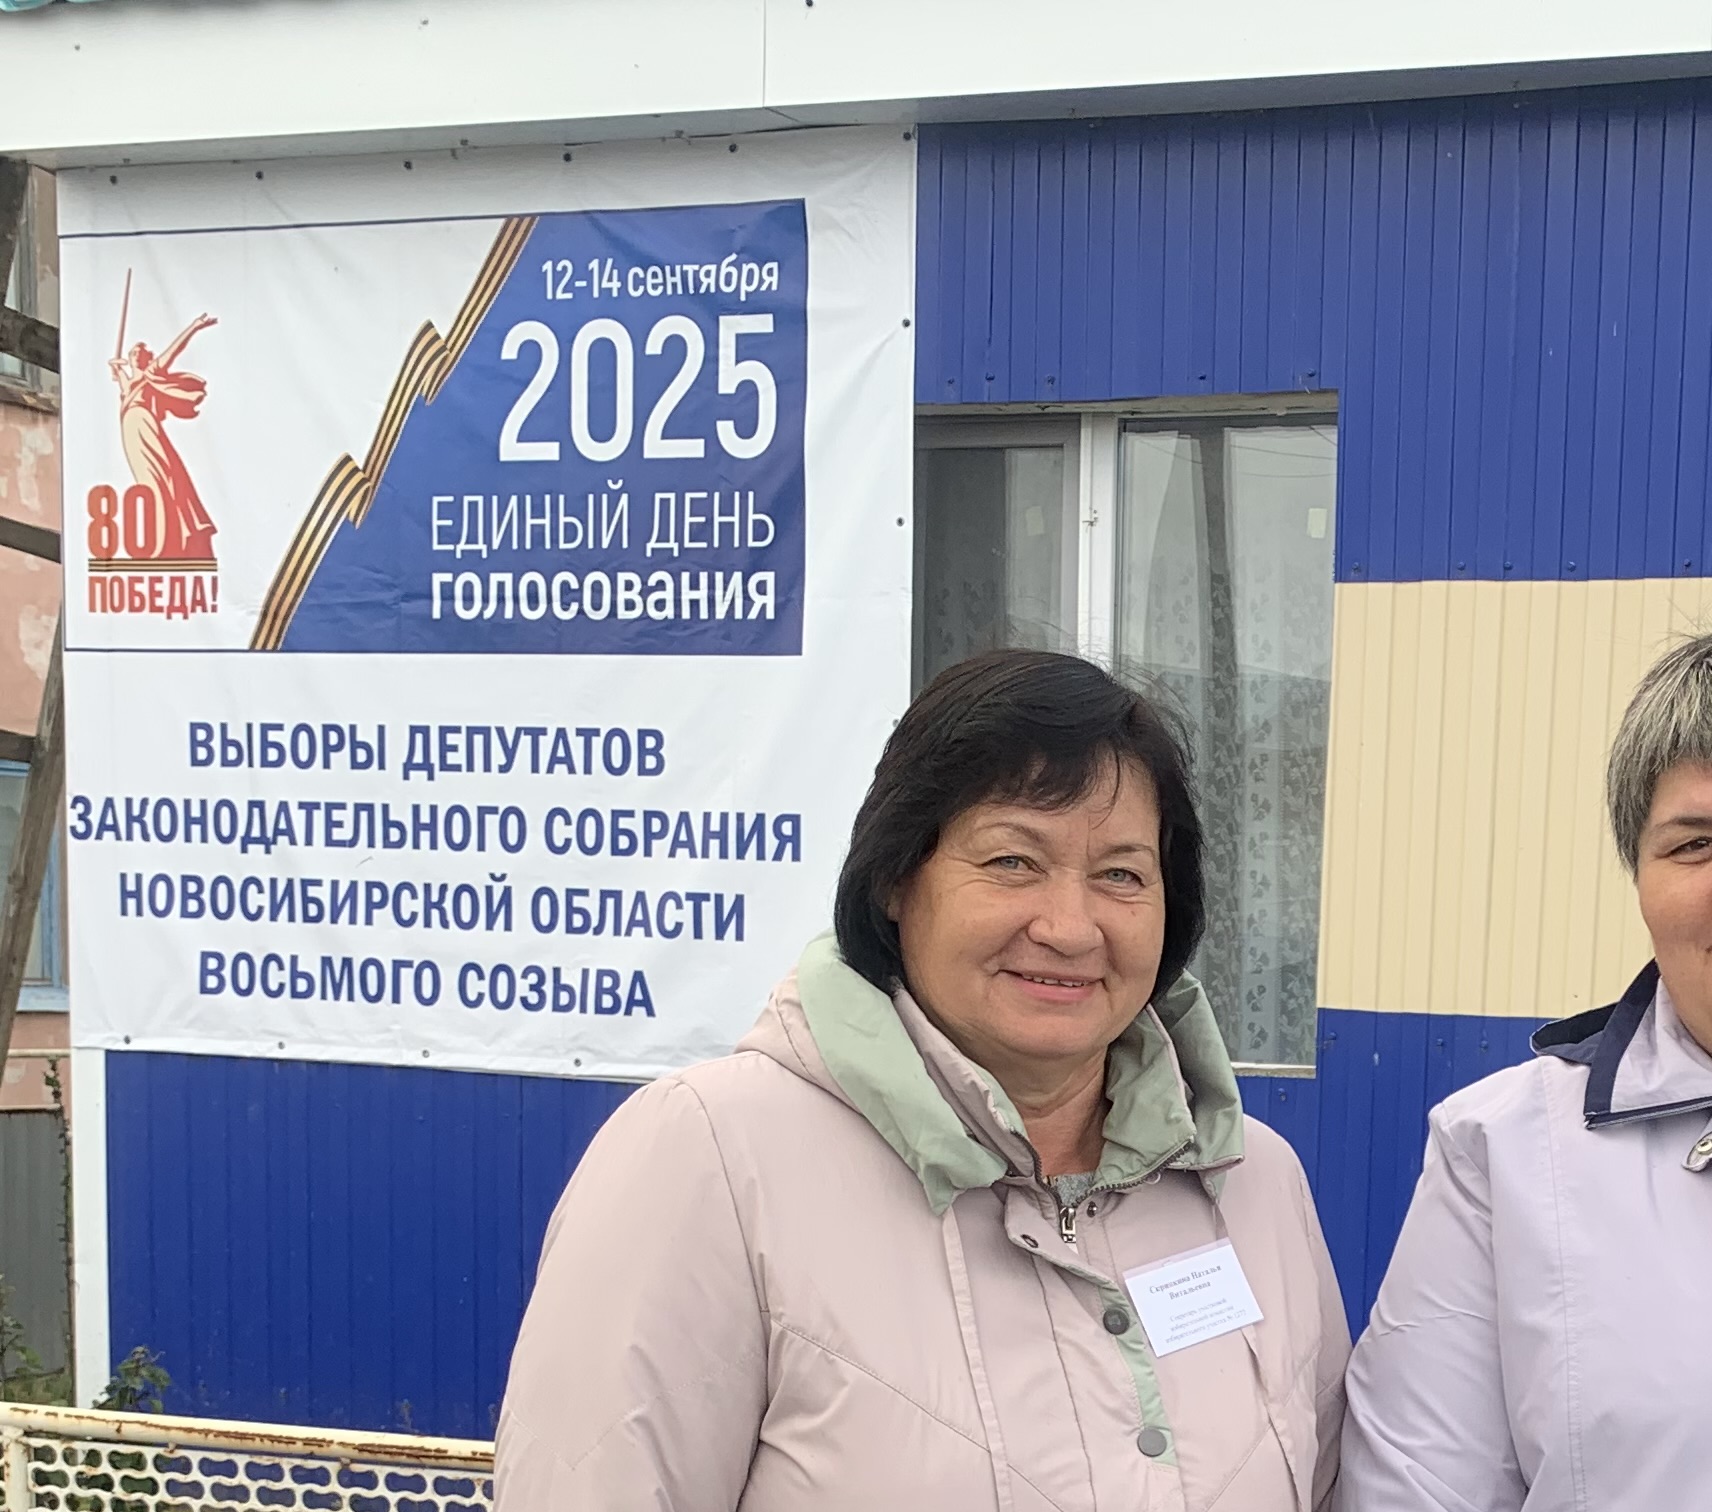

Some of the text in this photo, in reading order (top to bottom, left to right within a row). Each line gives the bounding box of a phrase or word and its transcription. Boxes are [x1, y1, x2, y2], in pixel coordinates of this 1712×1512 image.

[541, 252, 780, 301] 12-14 сентября
[498, 314, 777, 463] 2025
[88, 484, 156, 559] 80
[431, 480, 775, 558] ЕДИНЫЙ ДЕНЬ
[88, 574, 219, 621] ПОБЕДА!
[188, 720, 666, 781] ВЫБОРЫ ДЕПУТАТОВ
[69, 795, 803, 863] ЗАКОНОДАТЕЛЬНОГО СОБРАНИЯ
[118, 871, 746, 941] НОВОСИБИРСКОЙ ОБЛАСТИ
[198, 949, 656, 1018] ВОСЬМОГО СОЗЫВА
